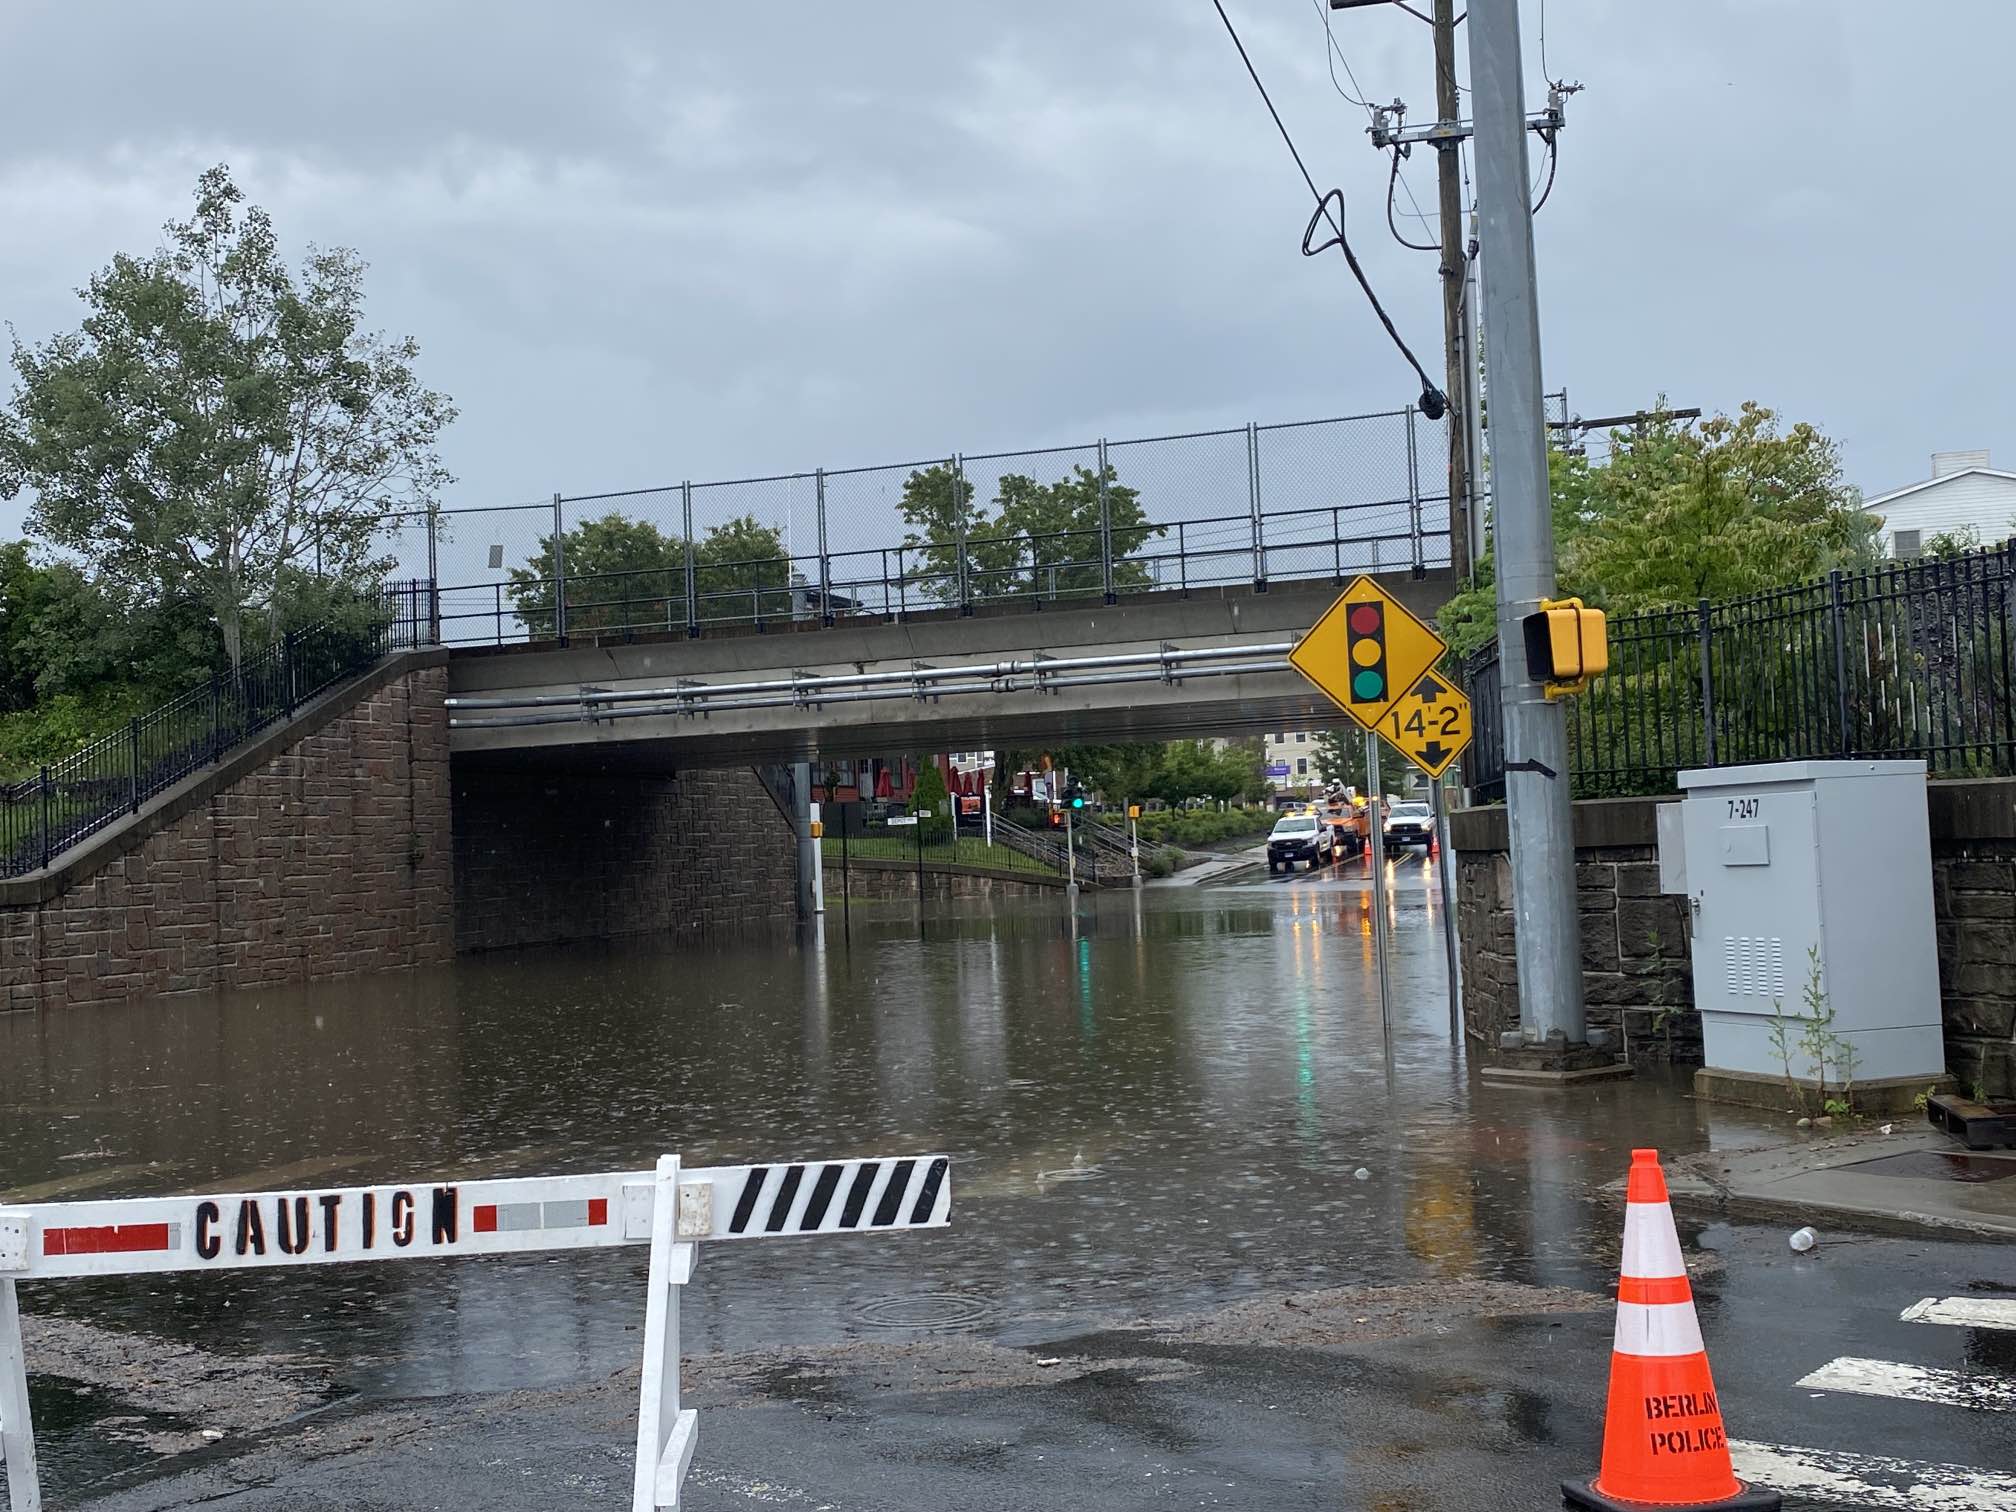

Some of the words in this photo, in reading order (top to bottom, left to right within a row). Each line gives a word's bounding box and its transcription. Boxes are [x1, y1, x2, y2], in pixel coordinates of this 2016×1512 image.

[1728, 799, 1759, 819] 7-247
[196, 1187, 459, 1260] CAUTION
[1645, 1392, 1718, 1419] BERLIN
[1650, 1426, 1725, 1455] POLICE
